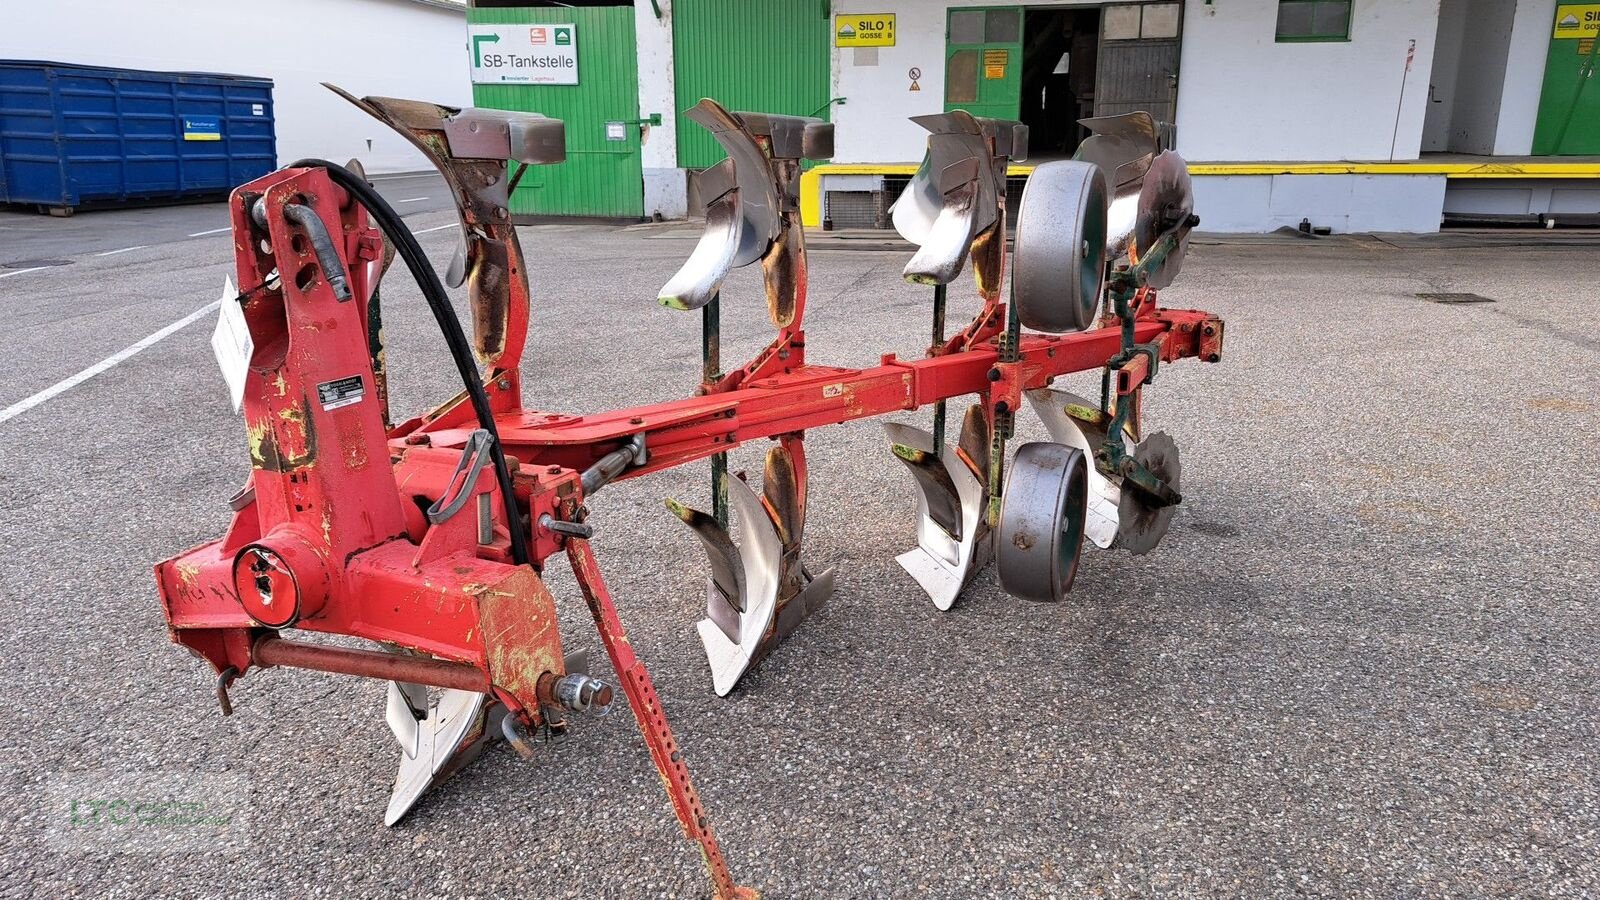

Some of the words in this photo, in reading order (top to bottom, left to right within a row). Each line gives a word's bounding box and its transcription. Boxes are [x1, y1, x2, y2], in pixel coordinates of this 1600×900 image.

[858, 21, 884, 30] SILO
[887, 21, 892, 30] 1
[483, 54, 574, 68] SB-Tankstelle
